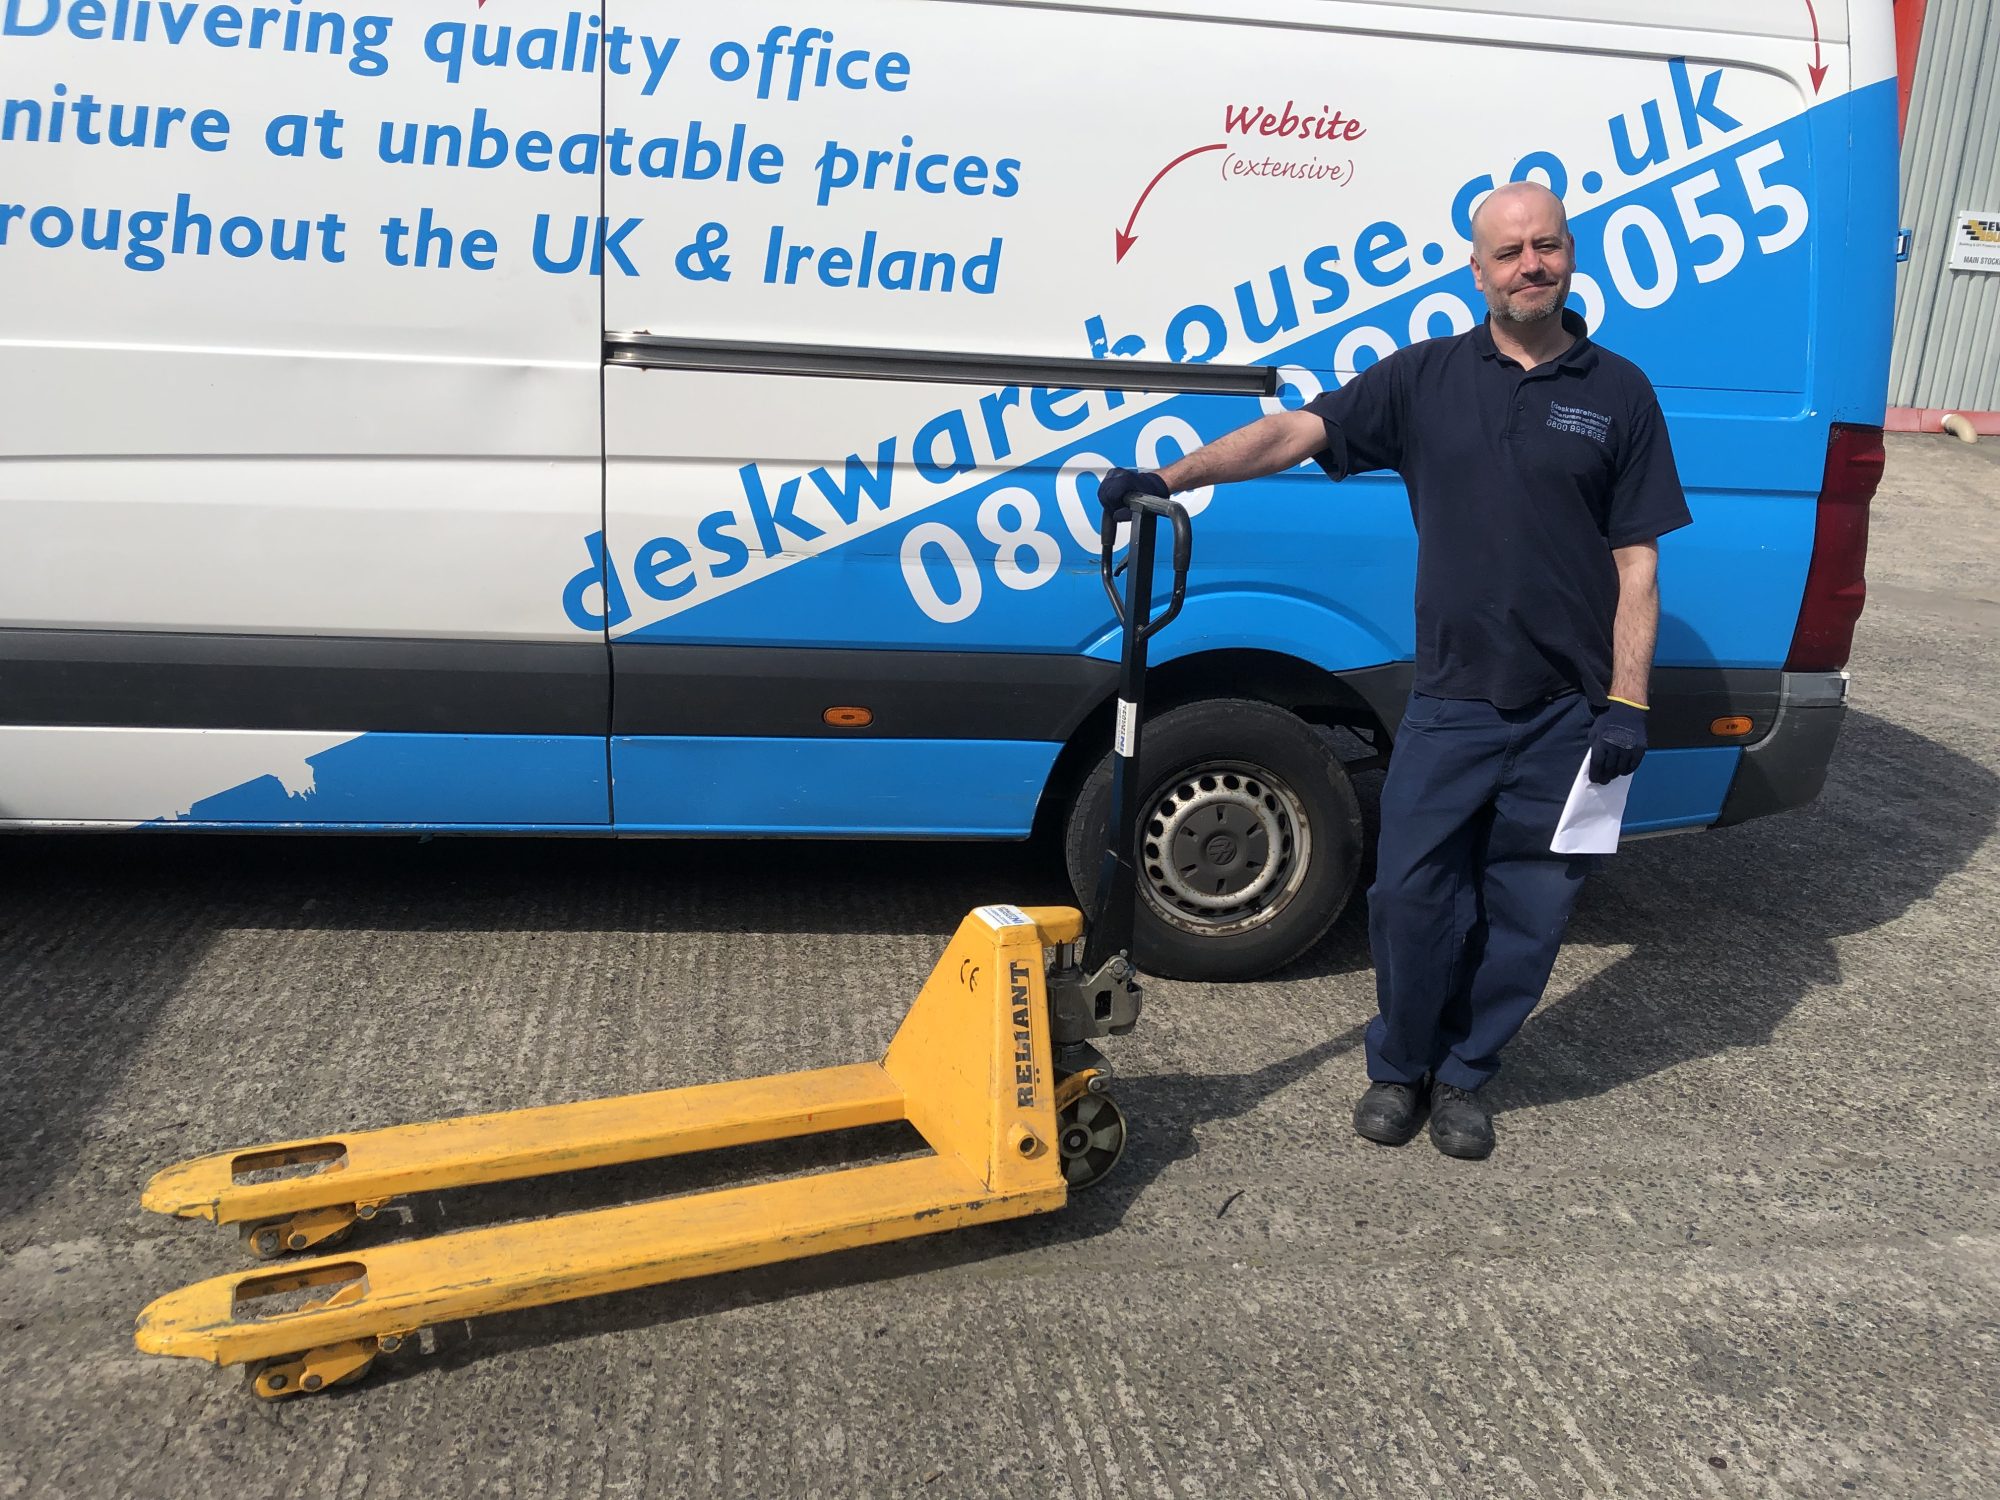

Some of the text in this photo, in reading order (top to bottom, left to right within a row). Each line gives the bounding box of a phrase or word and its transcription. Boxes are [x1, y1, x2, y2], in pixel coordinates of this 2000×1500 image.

[3, 0, 911, 102] Delivering quality office
[265, 109, 344, 160] at
[379, 108, 784, 185] unbeatable
[815, 135, 1022, 206] prices
[1225, 100, 1368, 141] Website
[1222, 152, 1354, 187] (extensive)
[380, 208, 498, 270] the
[532, 214, 645, 277] UK
[675, 222, 732, 282] &
[763, 225, 1003, 295] Ireland
[1570, 139, 1809, 335] 055
[1963, 256, 1979, 264] MAIN
[1546, 418, 1568, 432] 0800
[1010, 960, 1034, 1108] RELIANT
